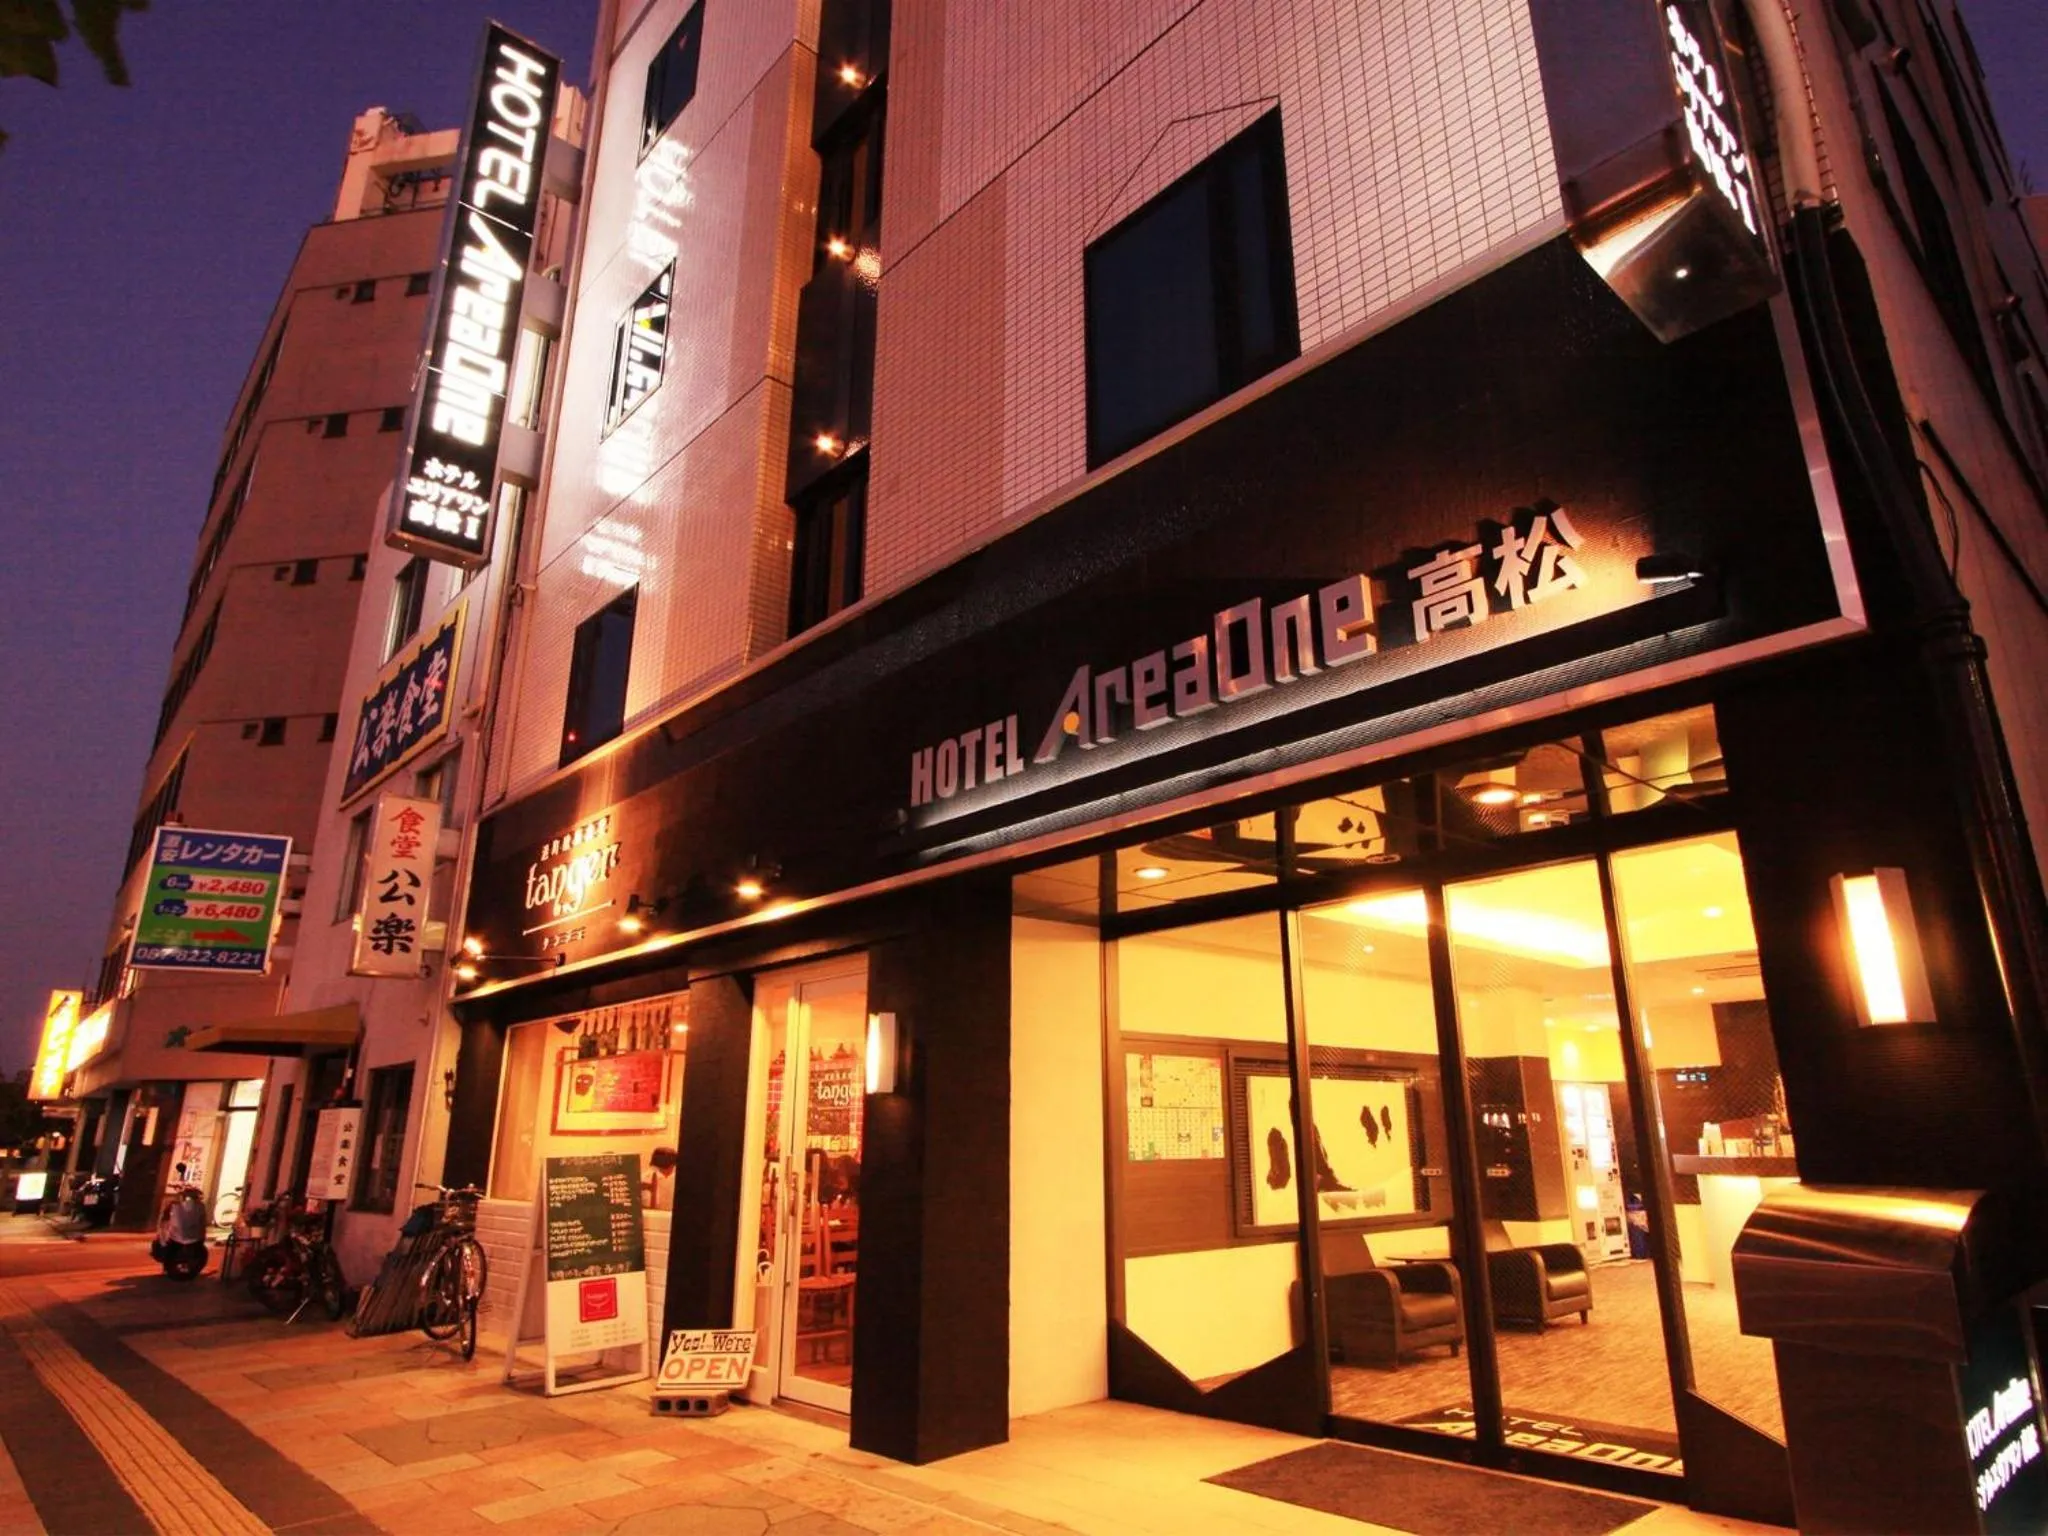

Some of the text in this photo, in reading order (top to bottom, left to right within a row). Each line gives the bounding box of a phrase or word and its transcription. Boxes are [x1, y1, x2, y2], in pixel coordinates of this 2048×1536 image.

[473, 43, 546, 207] HOTEL
[431, 211, 524, 447] AreaOne
[423, 456, 481, 490] ホテル
[405, 476, 490, 517] エリアワン
[910, 507, 1588, 807] HOTEL AreaOne 高松
[180, 840, 281, 865] レンタカー
[368, 805, 426, 956] 食堂 公楽
[671, 1332, 752, 1355] Yes! We're
[664, 1356, 748, 1380] OPEN
[1443, 1407, 1584, 1437] HTEL
